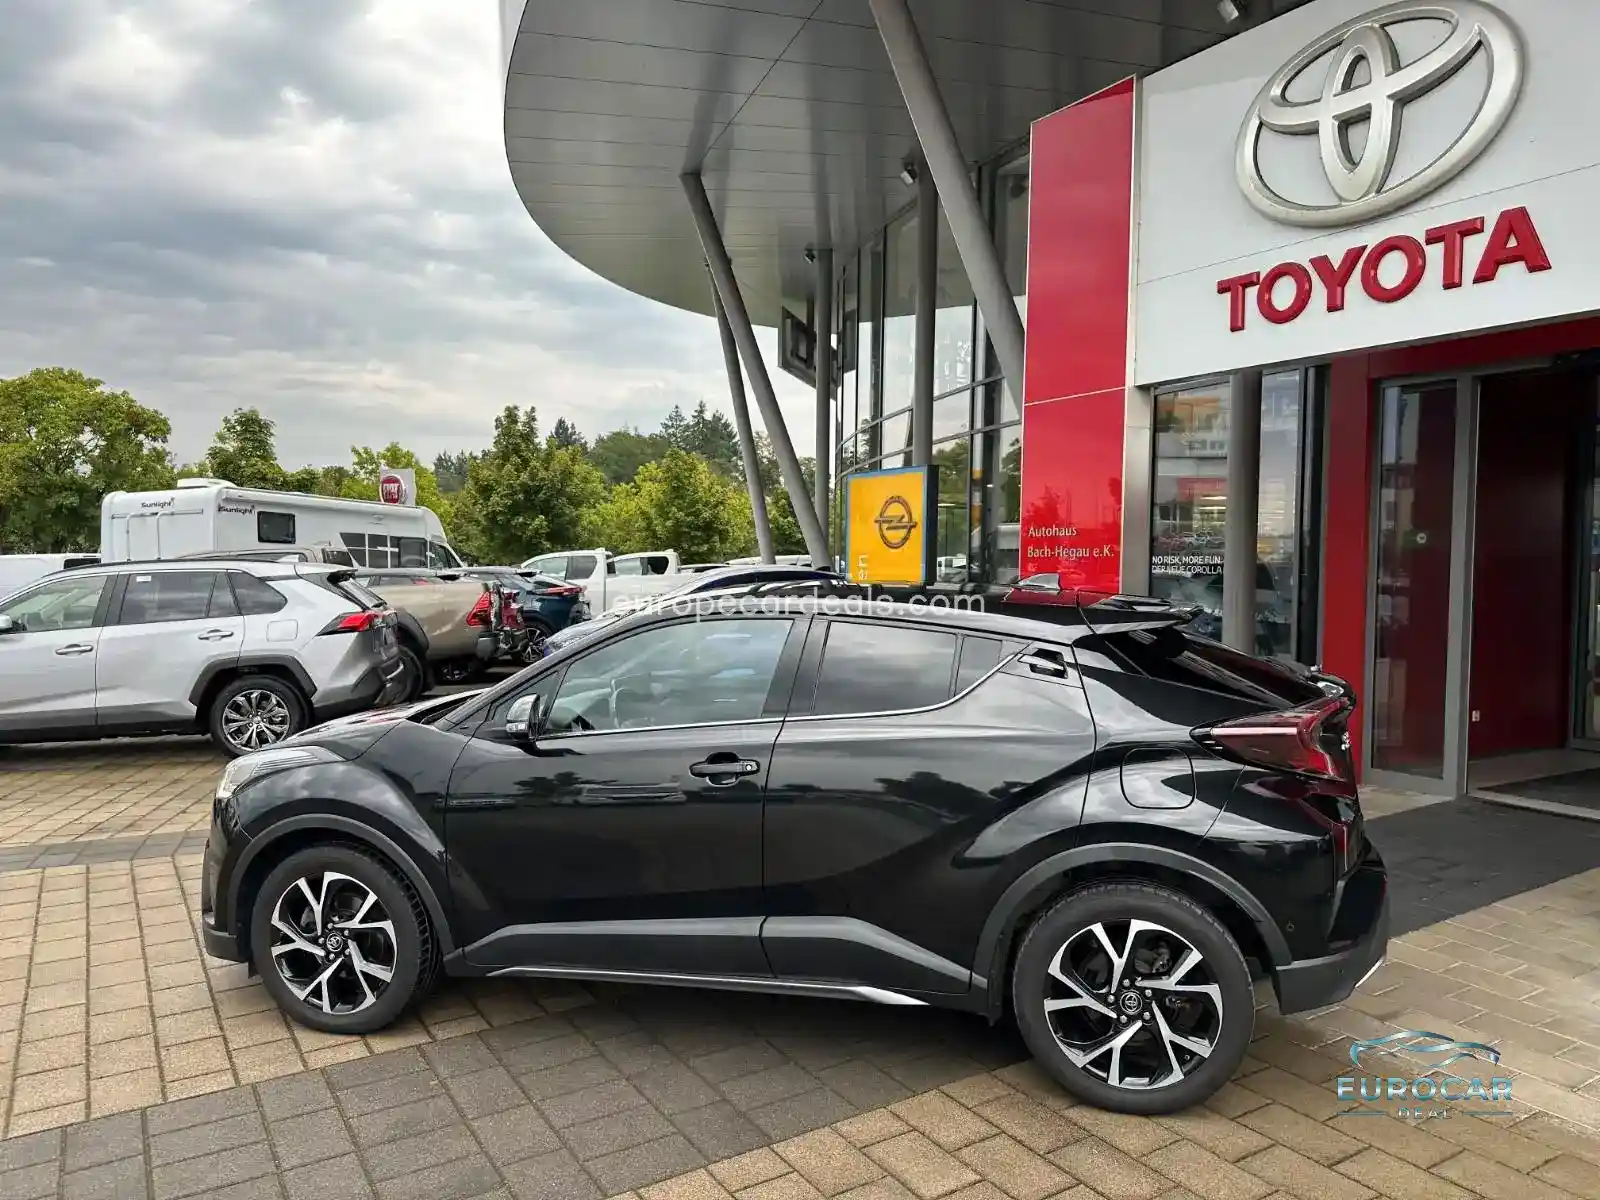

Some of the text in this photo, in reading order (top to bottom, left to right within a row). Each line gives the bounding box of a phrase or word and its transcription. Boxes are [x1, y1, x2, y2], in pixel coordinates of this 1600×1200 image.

[1217, 206, 1552, 332] TOYOTA
[141, 499, 172, 509] Sunlight
[219, 505, 253, 515] Sunlight
[1028, 524, 1077, 537] Autohaus
[1027, 544, 1115, 560] Bach-Hegau e.K.
[1152, 555, 1163, 565] NO
[1182, 555, 1203, 564] MORE
[1187, 565, 1222, 575] COROLLA
